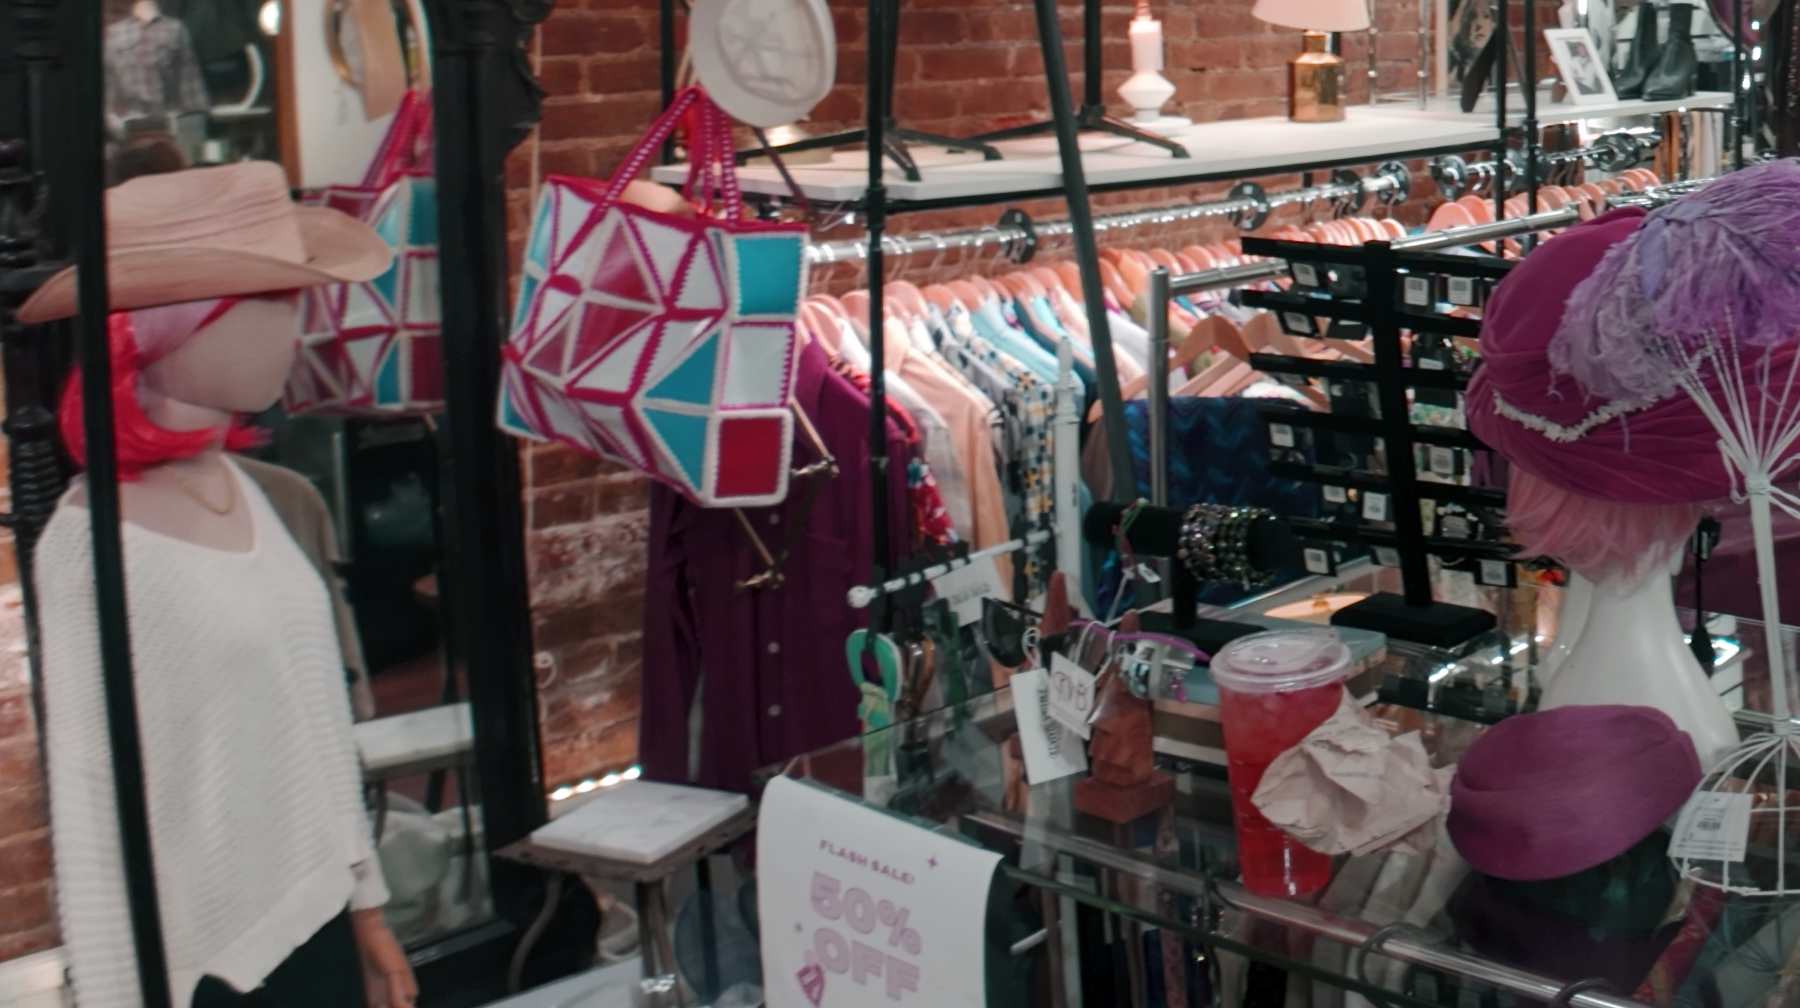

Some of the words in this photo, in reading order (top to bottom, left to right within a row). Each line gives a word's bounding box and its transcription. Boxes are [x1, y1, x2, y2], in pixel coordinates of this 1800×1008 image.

[819, 839, 869, 868] FLASH
[809, 870, 923, 957] 50%
[813, 927, 921, 1002] OFF
